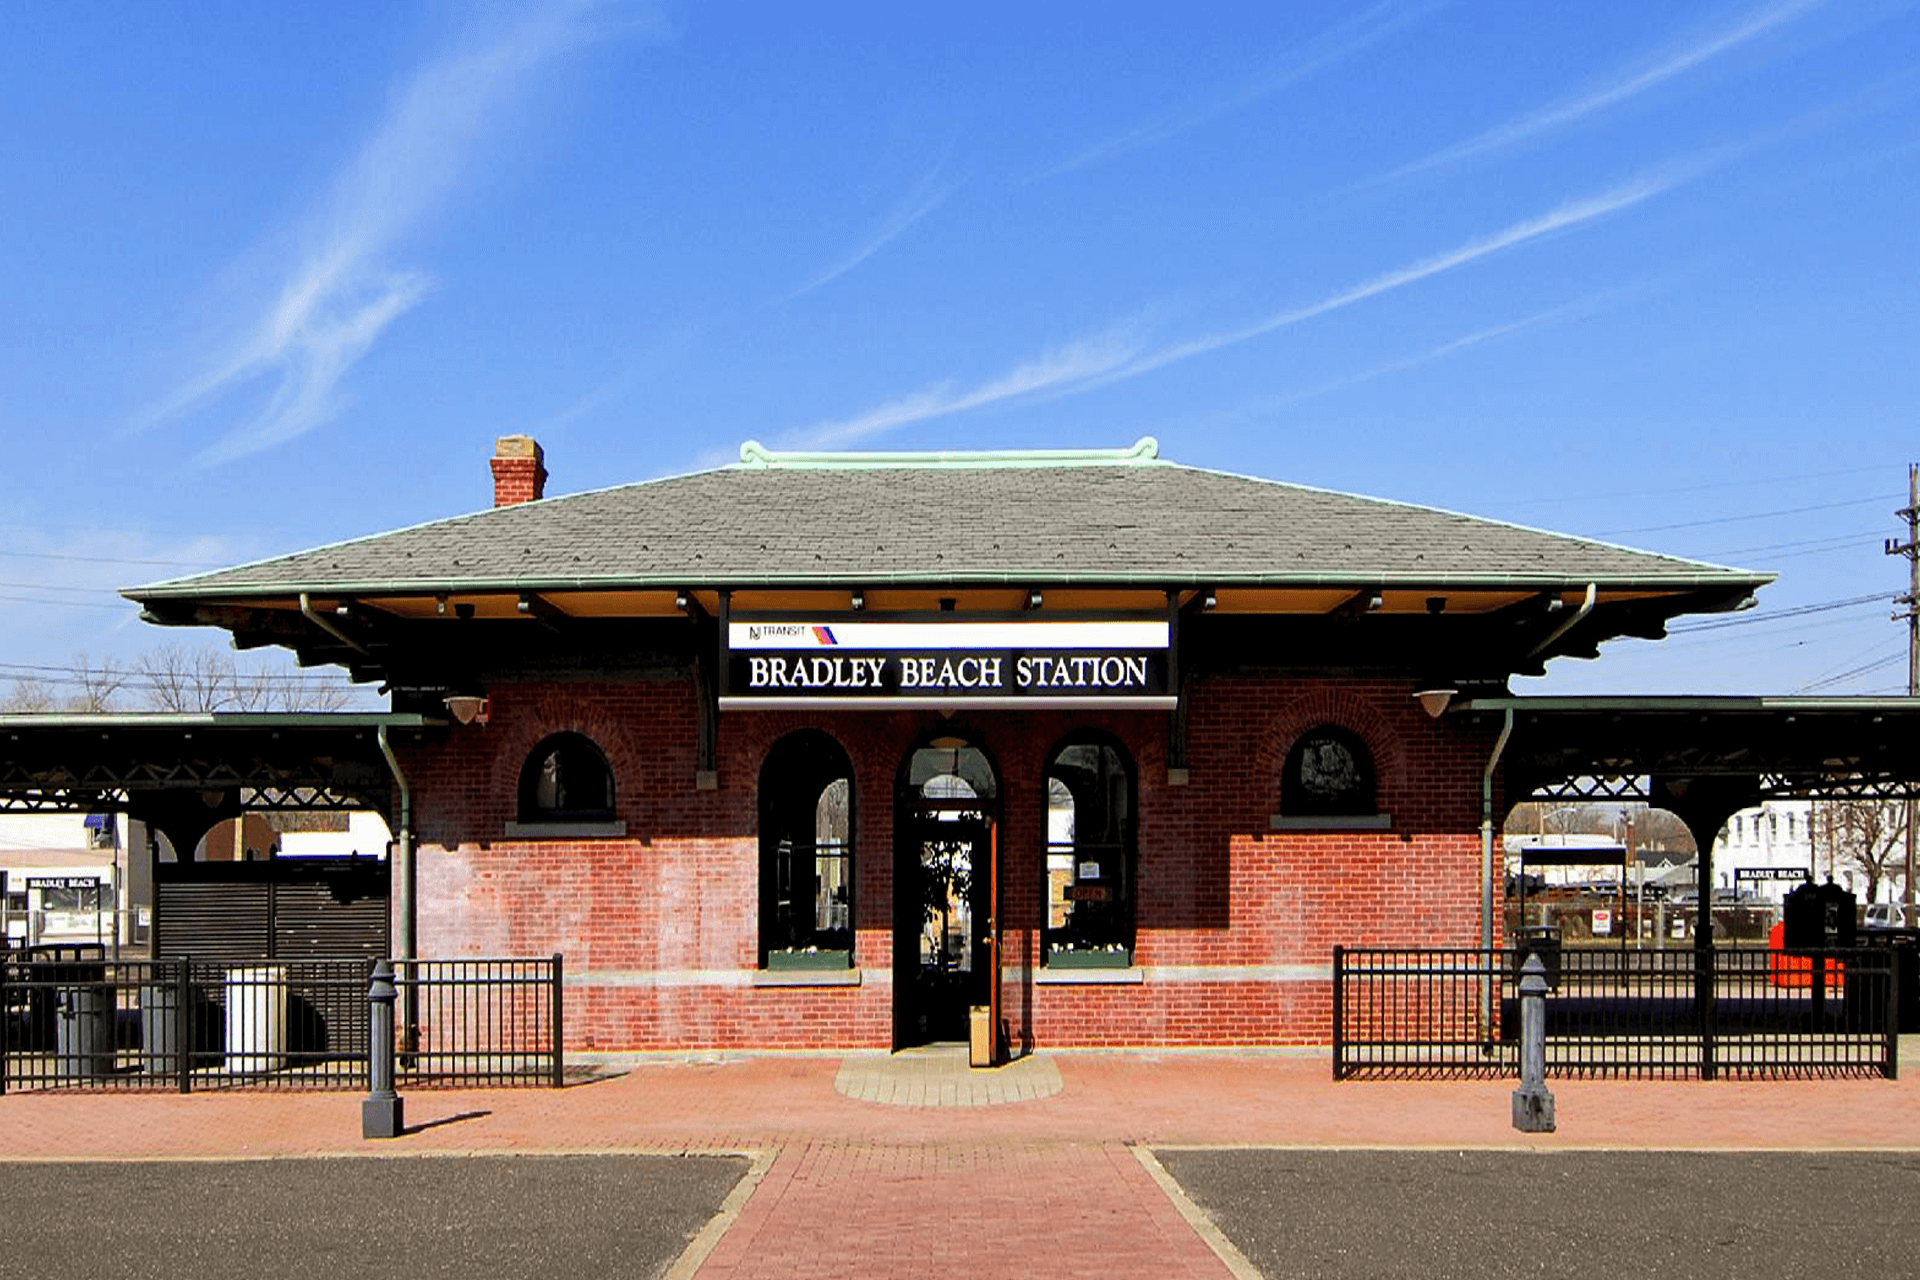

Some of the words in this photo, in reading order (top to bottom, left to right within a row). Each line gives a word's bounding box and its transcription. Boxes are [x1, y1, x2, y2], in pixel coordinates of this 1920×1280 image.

[763, 626, 805, 636] TRANSIT
[749, 657, 886, 687] BRADLEY
[900, 657, 1003, 687] BEACH
[1016, 656, 1148, 687] STATION
[1740, 870, 1775, 879] BRADLEY
[1778, 870, 1804, 878] BEACH
[30, 879, 65, 888] BRADLEY
[68, 879, 95, 887] BEACH
[1074, 887, 1103, 899] OPEN
